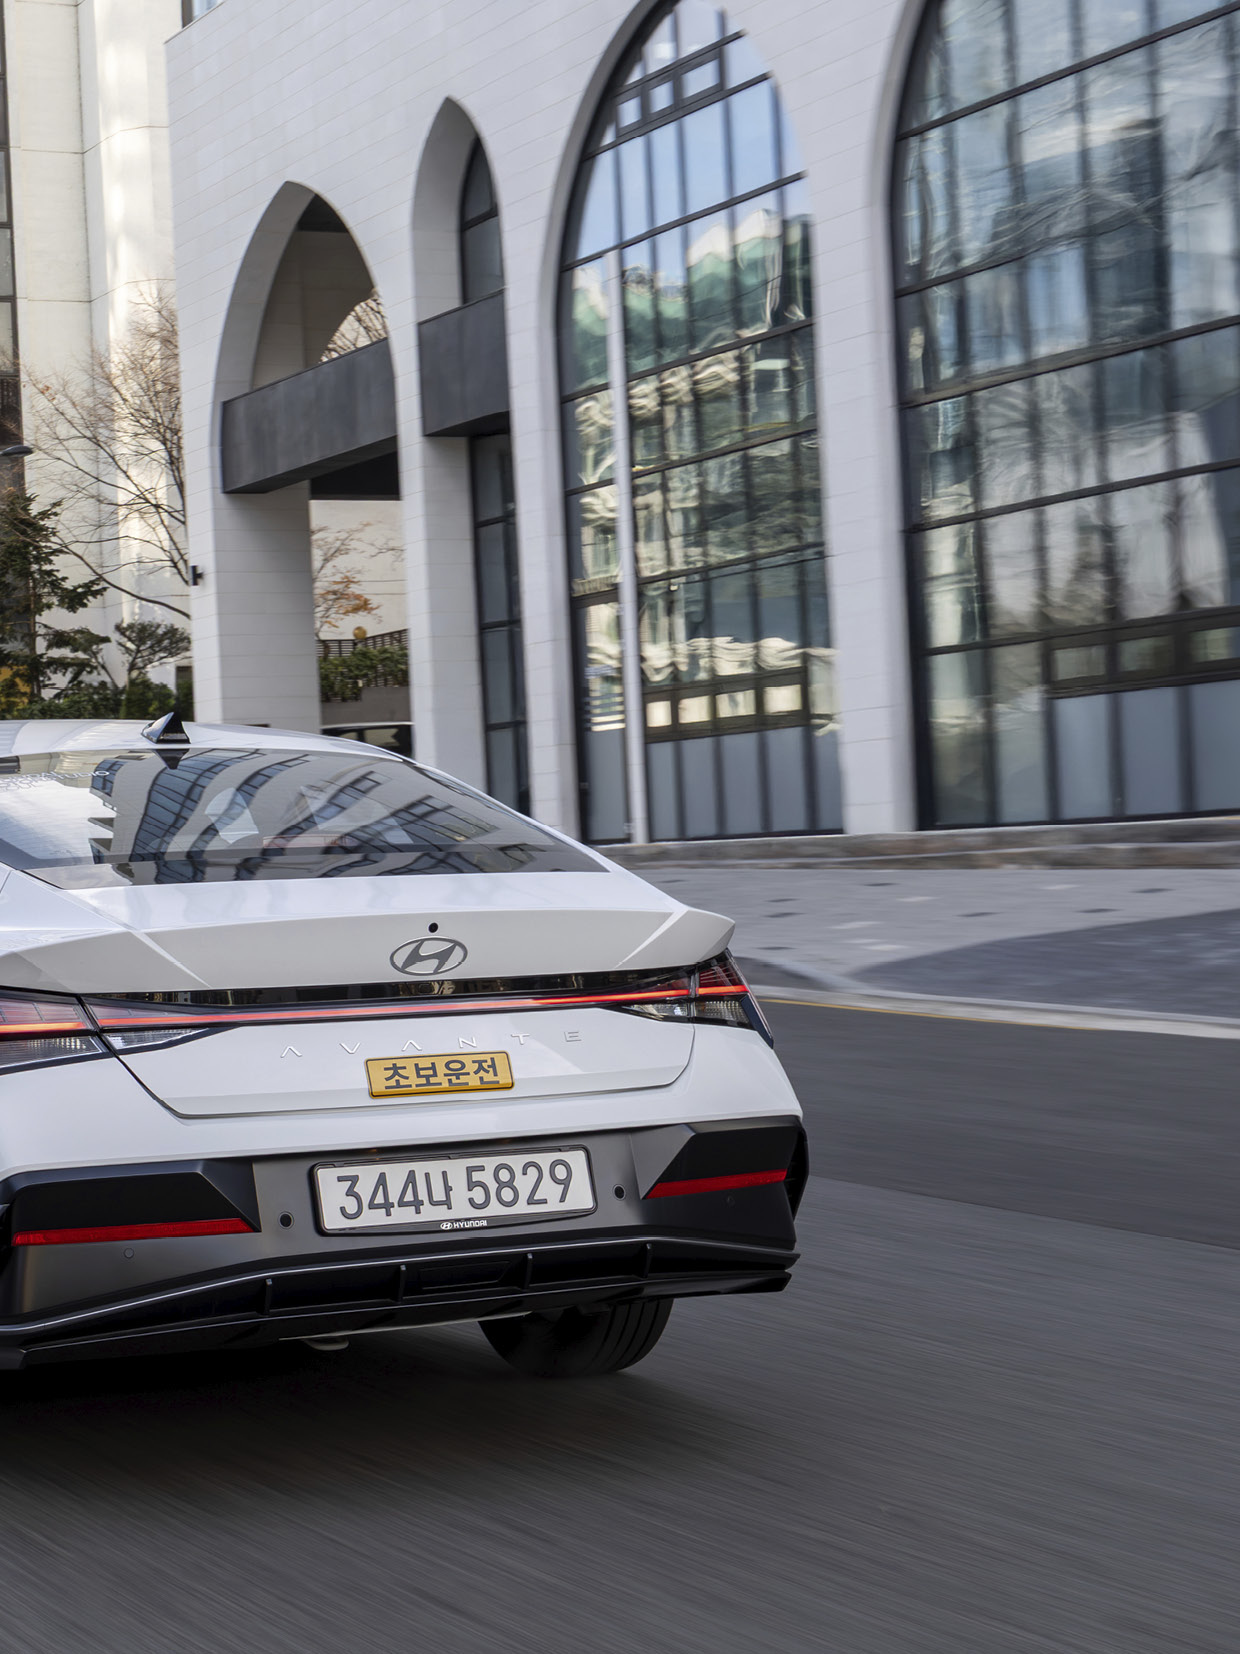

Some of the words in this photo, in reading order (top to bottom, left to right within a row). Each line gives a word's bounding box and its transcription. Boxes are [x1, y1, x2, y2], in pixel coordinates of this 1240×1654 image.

[280, 1030, 582, 1058] AVANTE
[383, 1057, 501, 1091] 초보운전
[336, 1169, 453, 1220] 344나
[465, 1158, 573, 1210] 5829
[453, 1220, 488, 1229] HYUNDAI
